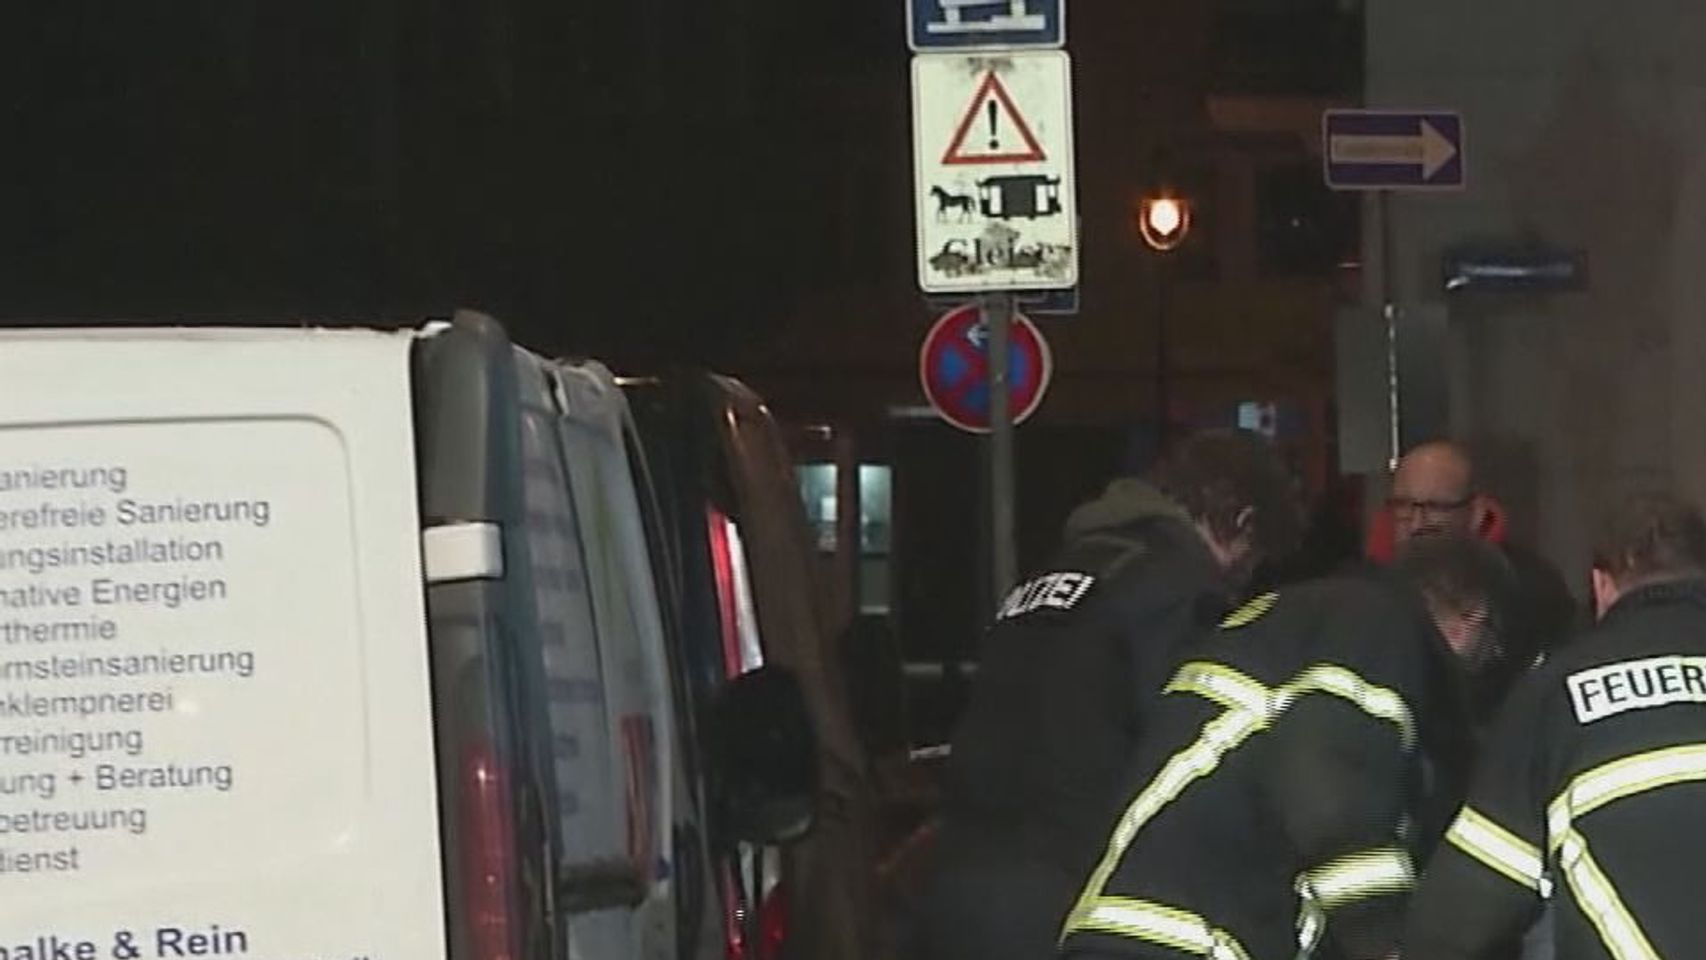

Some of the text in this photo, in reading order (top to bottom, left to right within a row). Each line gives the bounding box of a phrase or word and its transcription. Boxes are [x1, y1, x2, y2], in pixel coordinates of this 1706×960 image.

[115, 497, 271, 527] Sanierung
[90, 577, 227, 607] Energien
[0, 648, 255, 679] rnsteinsanierung
[68, 771, 86, 787] +
[95, 763, 234, 792] Beratung
[156, 924, 249, 957] Rein
